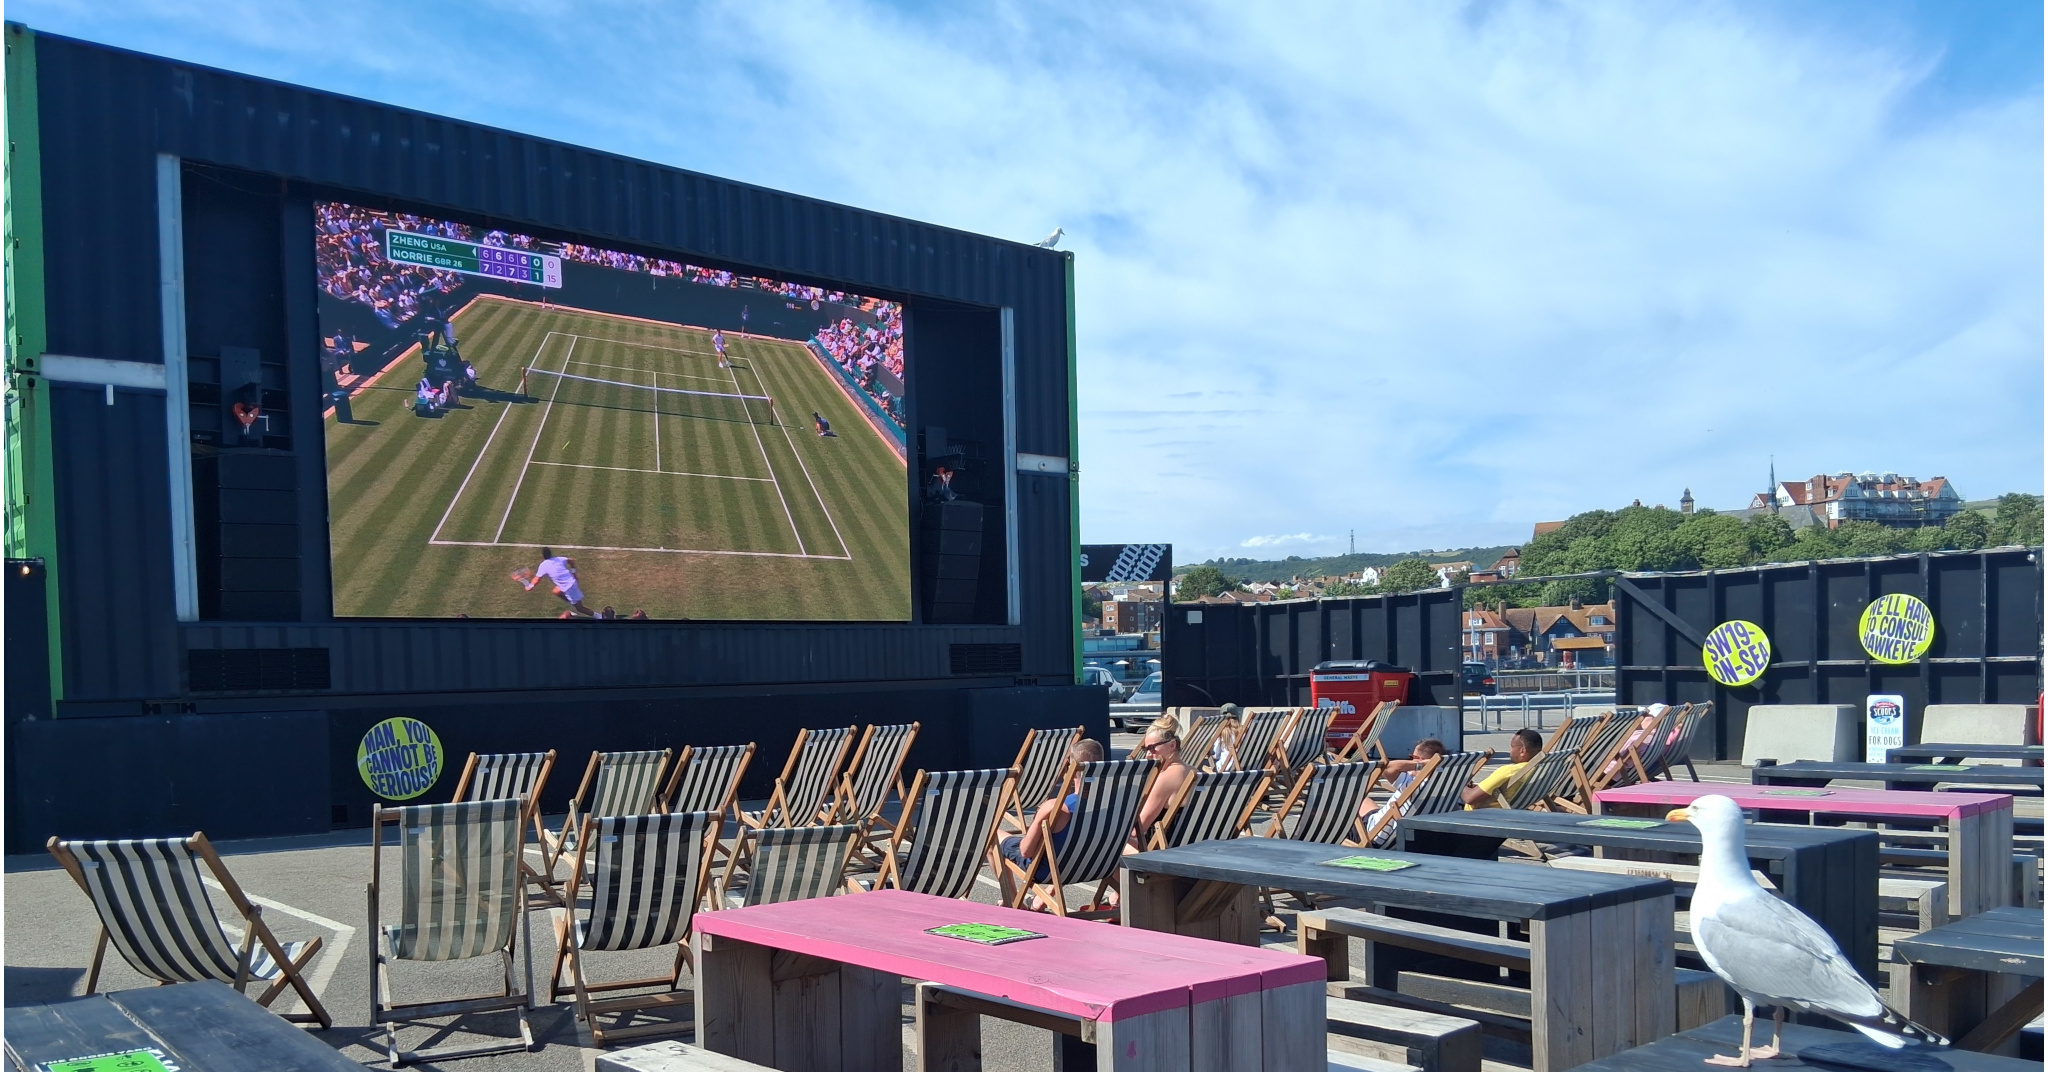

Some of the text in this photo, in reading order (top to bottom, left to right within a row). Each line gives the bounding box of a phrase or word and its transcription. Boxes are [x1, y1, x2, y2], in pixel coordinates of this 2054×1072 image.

[392, 235, 554, 269] ZHENG USA 6 6 6 6 0 0
[392, 249, 557, 283] NORRIE GBR 26 7 2 7 3 1 15
[1865, 616, 1929, 641] TO CONSULT
[1870, 595, 1931, 628] WE'LL HAVE
[1705, 621, 1756, 662] SW19-
[1713, 641, 1769, 684] ON-SEA
[364, 719, 432, 757] MAN, YOU
[1868, 735, 1902, 746] FOR DOGS
[366, 743, 437, 774] CANNOT BE
[371, 761, 439, 797] SERIOUS!?
